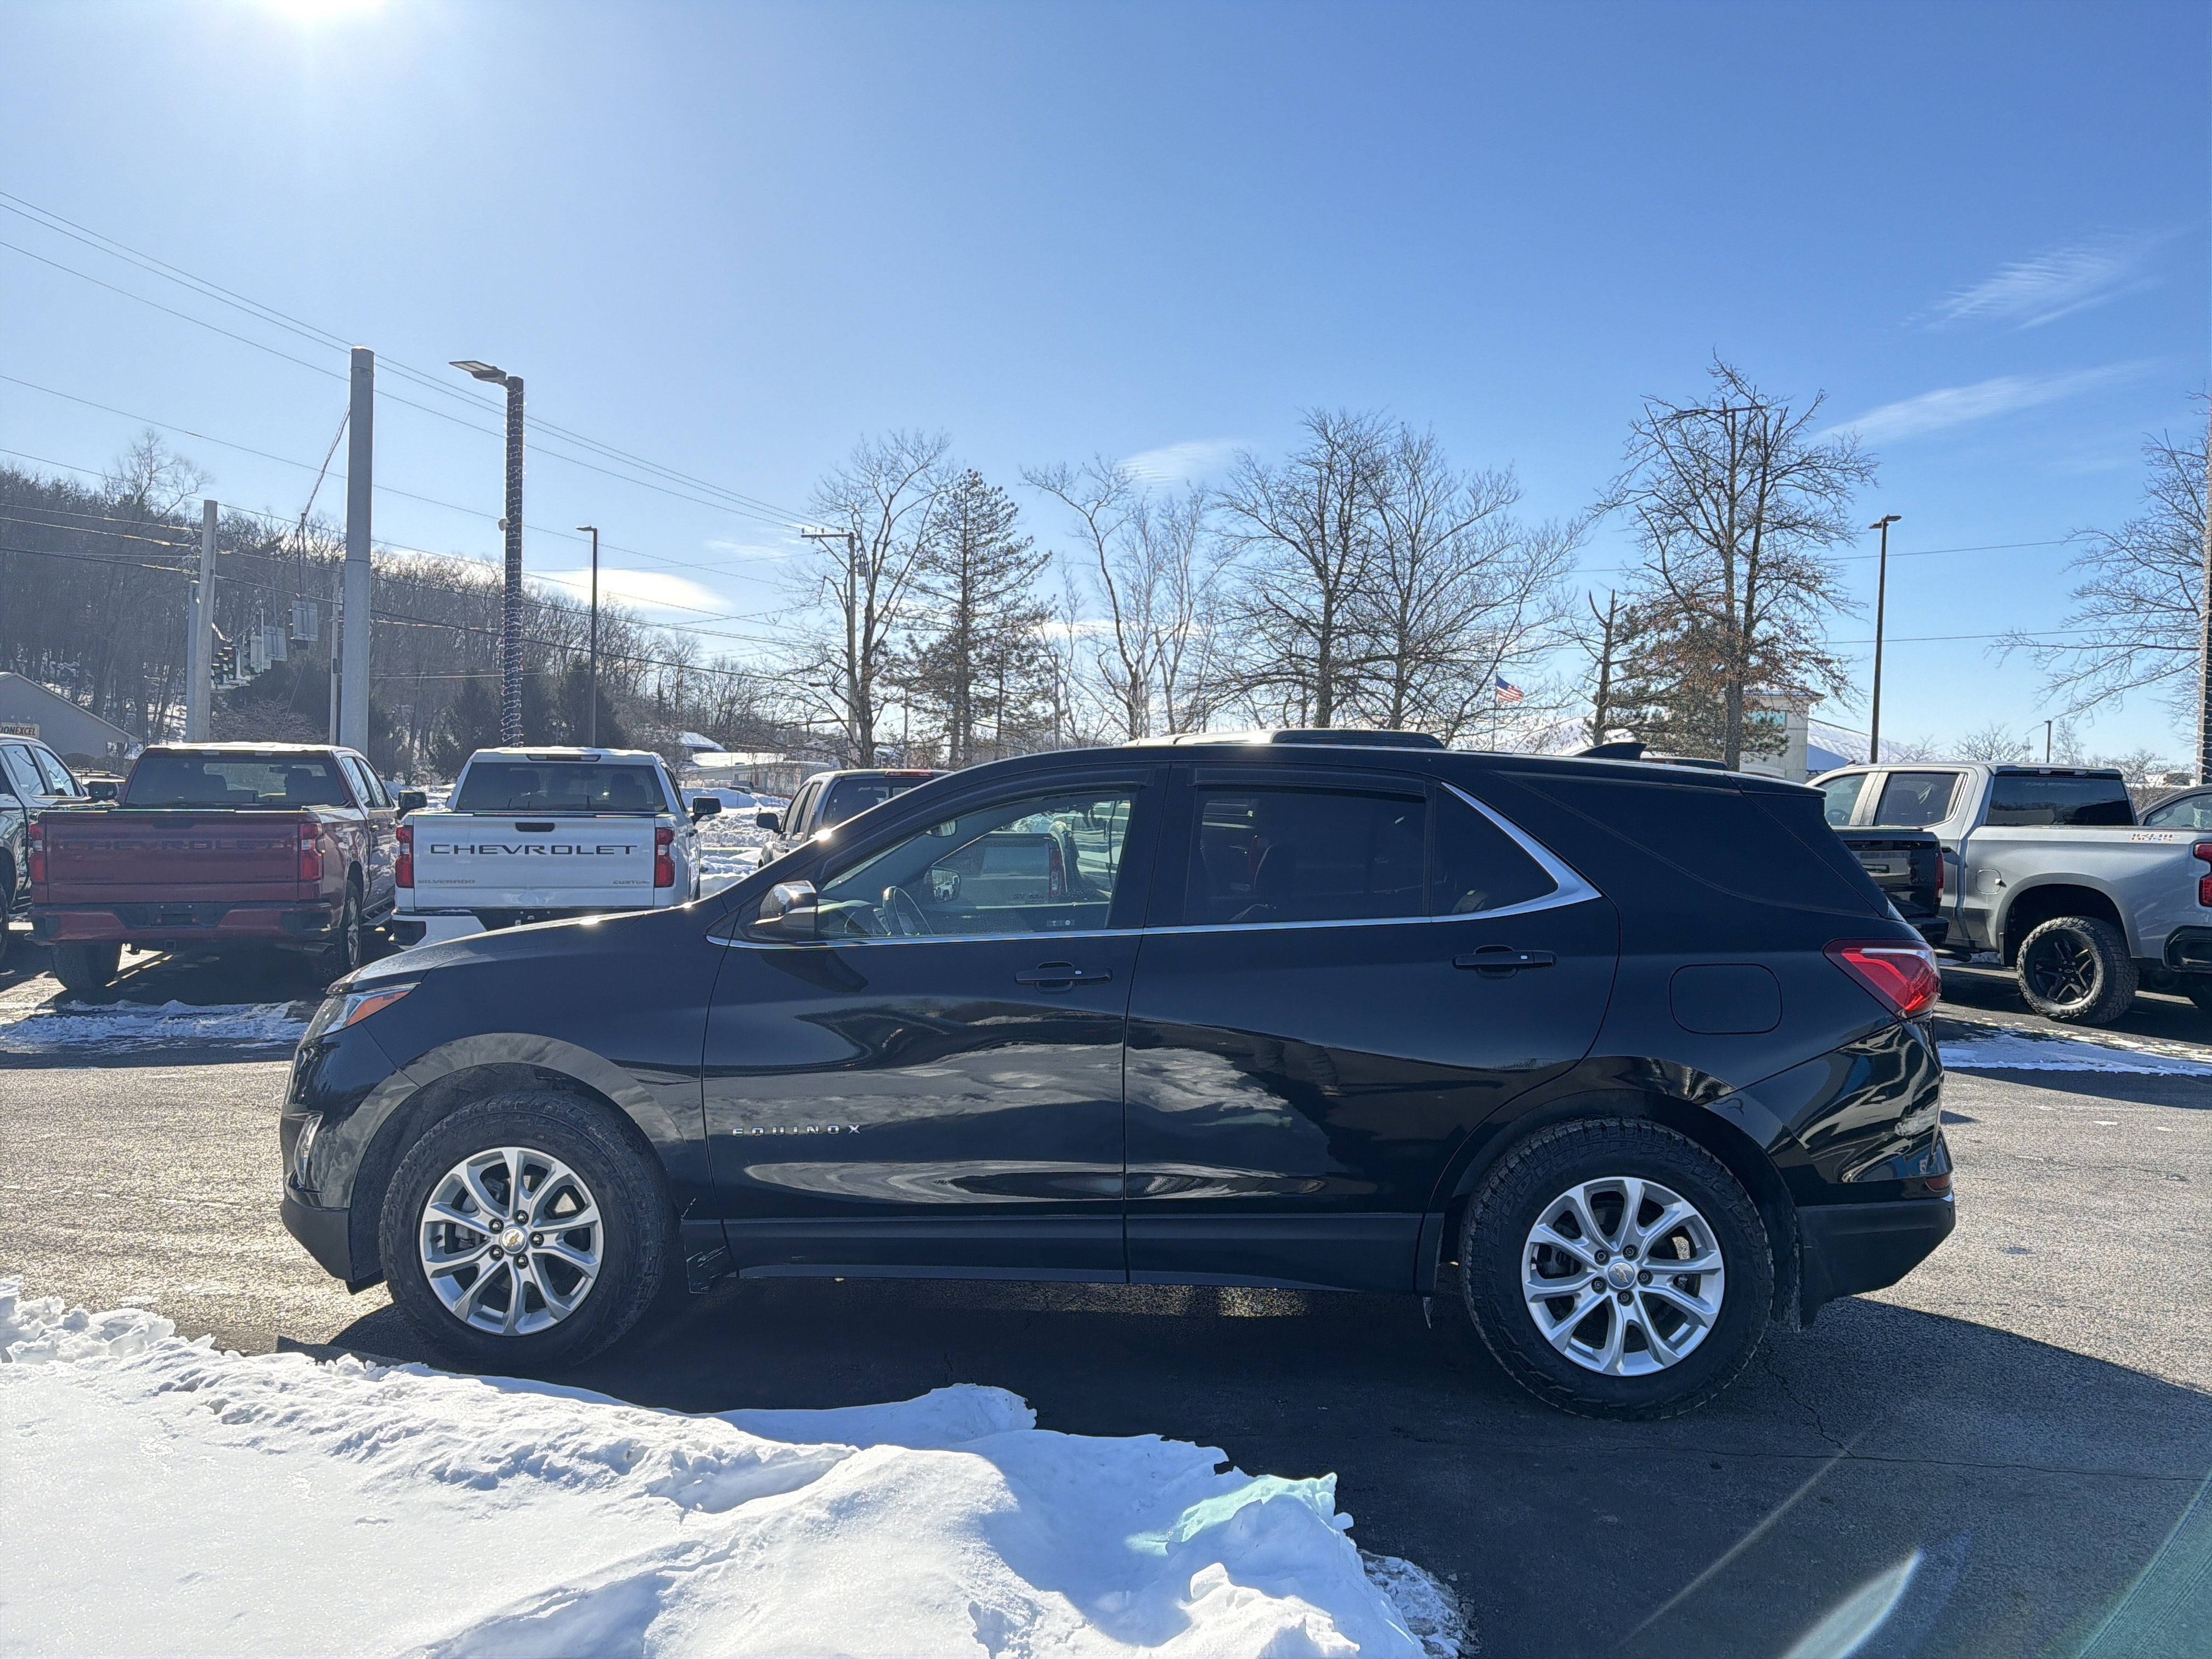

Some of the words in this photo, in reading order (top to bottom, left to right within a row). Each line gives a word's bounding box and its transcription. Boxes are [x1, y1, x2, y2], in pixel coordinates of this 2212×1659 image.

[63, 840, 284, 851] CHEVROLET
[430, 844, 637, 855] CHEVROLET
[732, 1125, 861, 1137] EQUINOX
